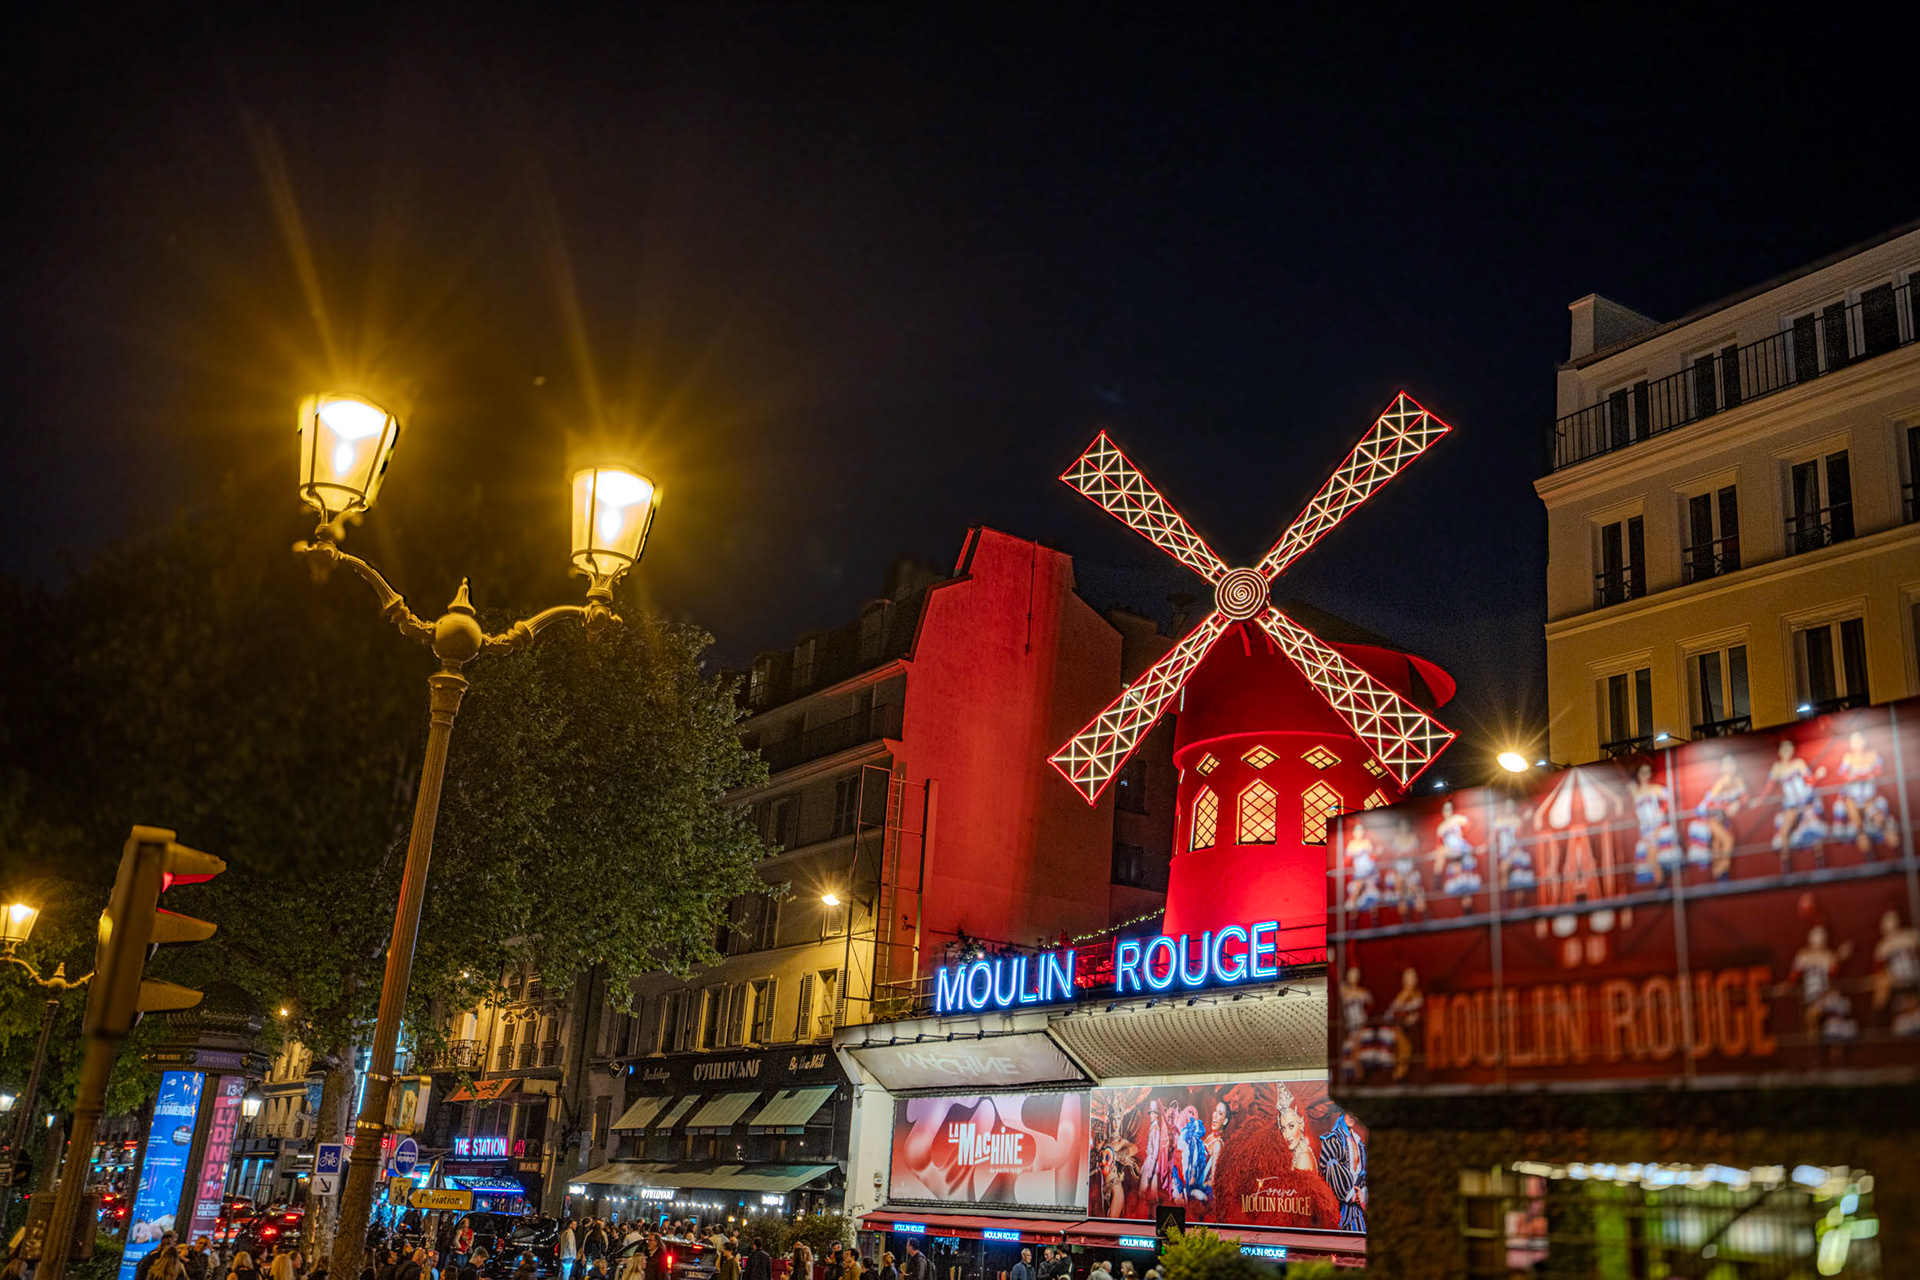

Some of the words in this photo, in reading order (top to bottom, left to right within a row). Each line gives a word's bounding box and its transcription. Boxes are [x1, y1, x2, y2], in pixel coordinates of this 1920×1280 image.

[935, 950, 1075, 1012] MOULIN
[1116, 920, 1280, 992] ROUGE
[1425, 982, 1589, 1069] MOULIN
[1603, 966, 1776, 1063] ROUGE
[693, 1058, 762, 1081] O'SULLIVANS
[811, 1053, 826, 1069] Mill
[949, 1123, 958, 1138] LA
[454, 1137, 469, 1155] THE
[472, 1137, 508, 1156] STATION
[520, 1162, 538, 1172] BAR
[1252, 1176, 1297, 1197] Forever
[1241, 1194, 1276, 1213] MOULIN
[1278, 1196, 1311, 1216] ROUGE
[894, 1223, 911, 1232] MOULIN
[911, 1225, 925, 1233] ROUGE
[984, 1230, 1001, 1239] MOULIN
[1002, 1232, 1019, 1241] ROUGE
